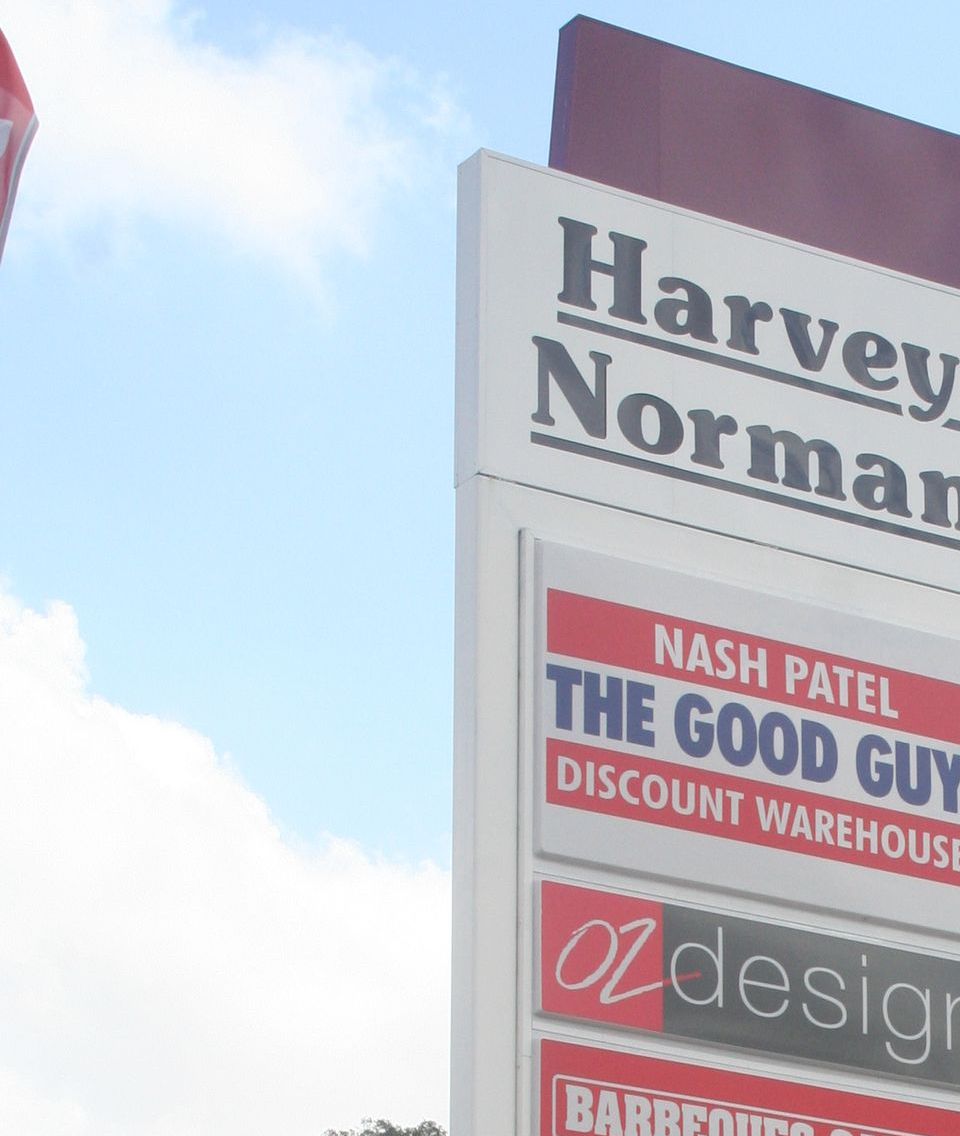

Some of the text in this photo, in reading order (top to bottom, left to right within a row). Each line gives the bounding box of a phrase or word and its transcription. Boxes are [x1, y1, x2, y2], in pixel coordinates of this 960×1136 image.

[557, 216, 960, 423] Harvey
[546, 663, 655, 748] THE
[674, 692, 838, 784] GOOD
[654, 623, 898, 719] NASH PATEL
[557, 756, 744, 826] DISCOUNT
